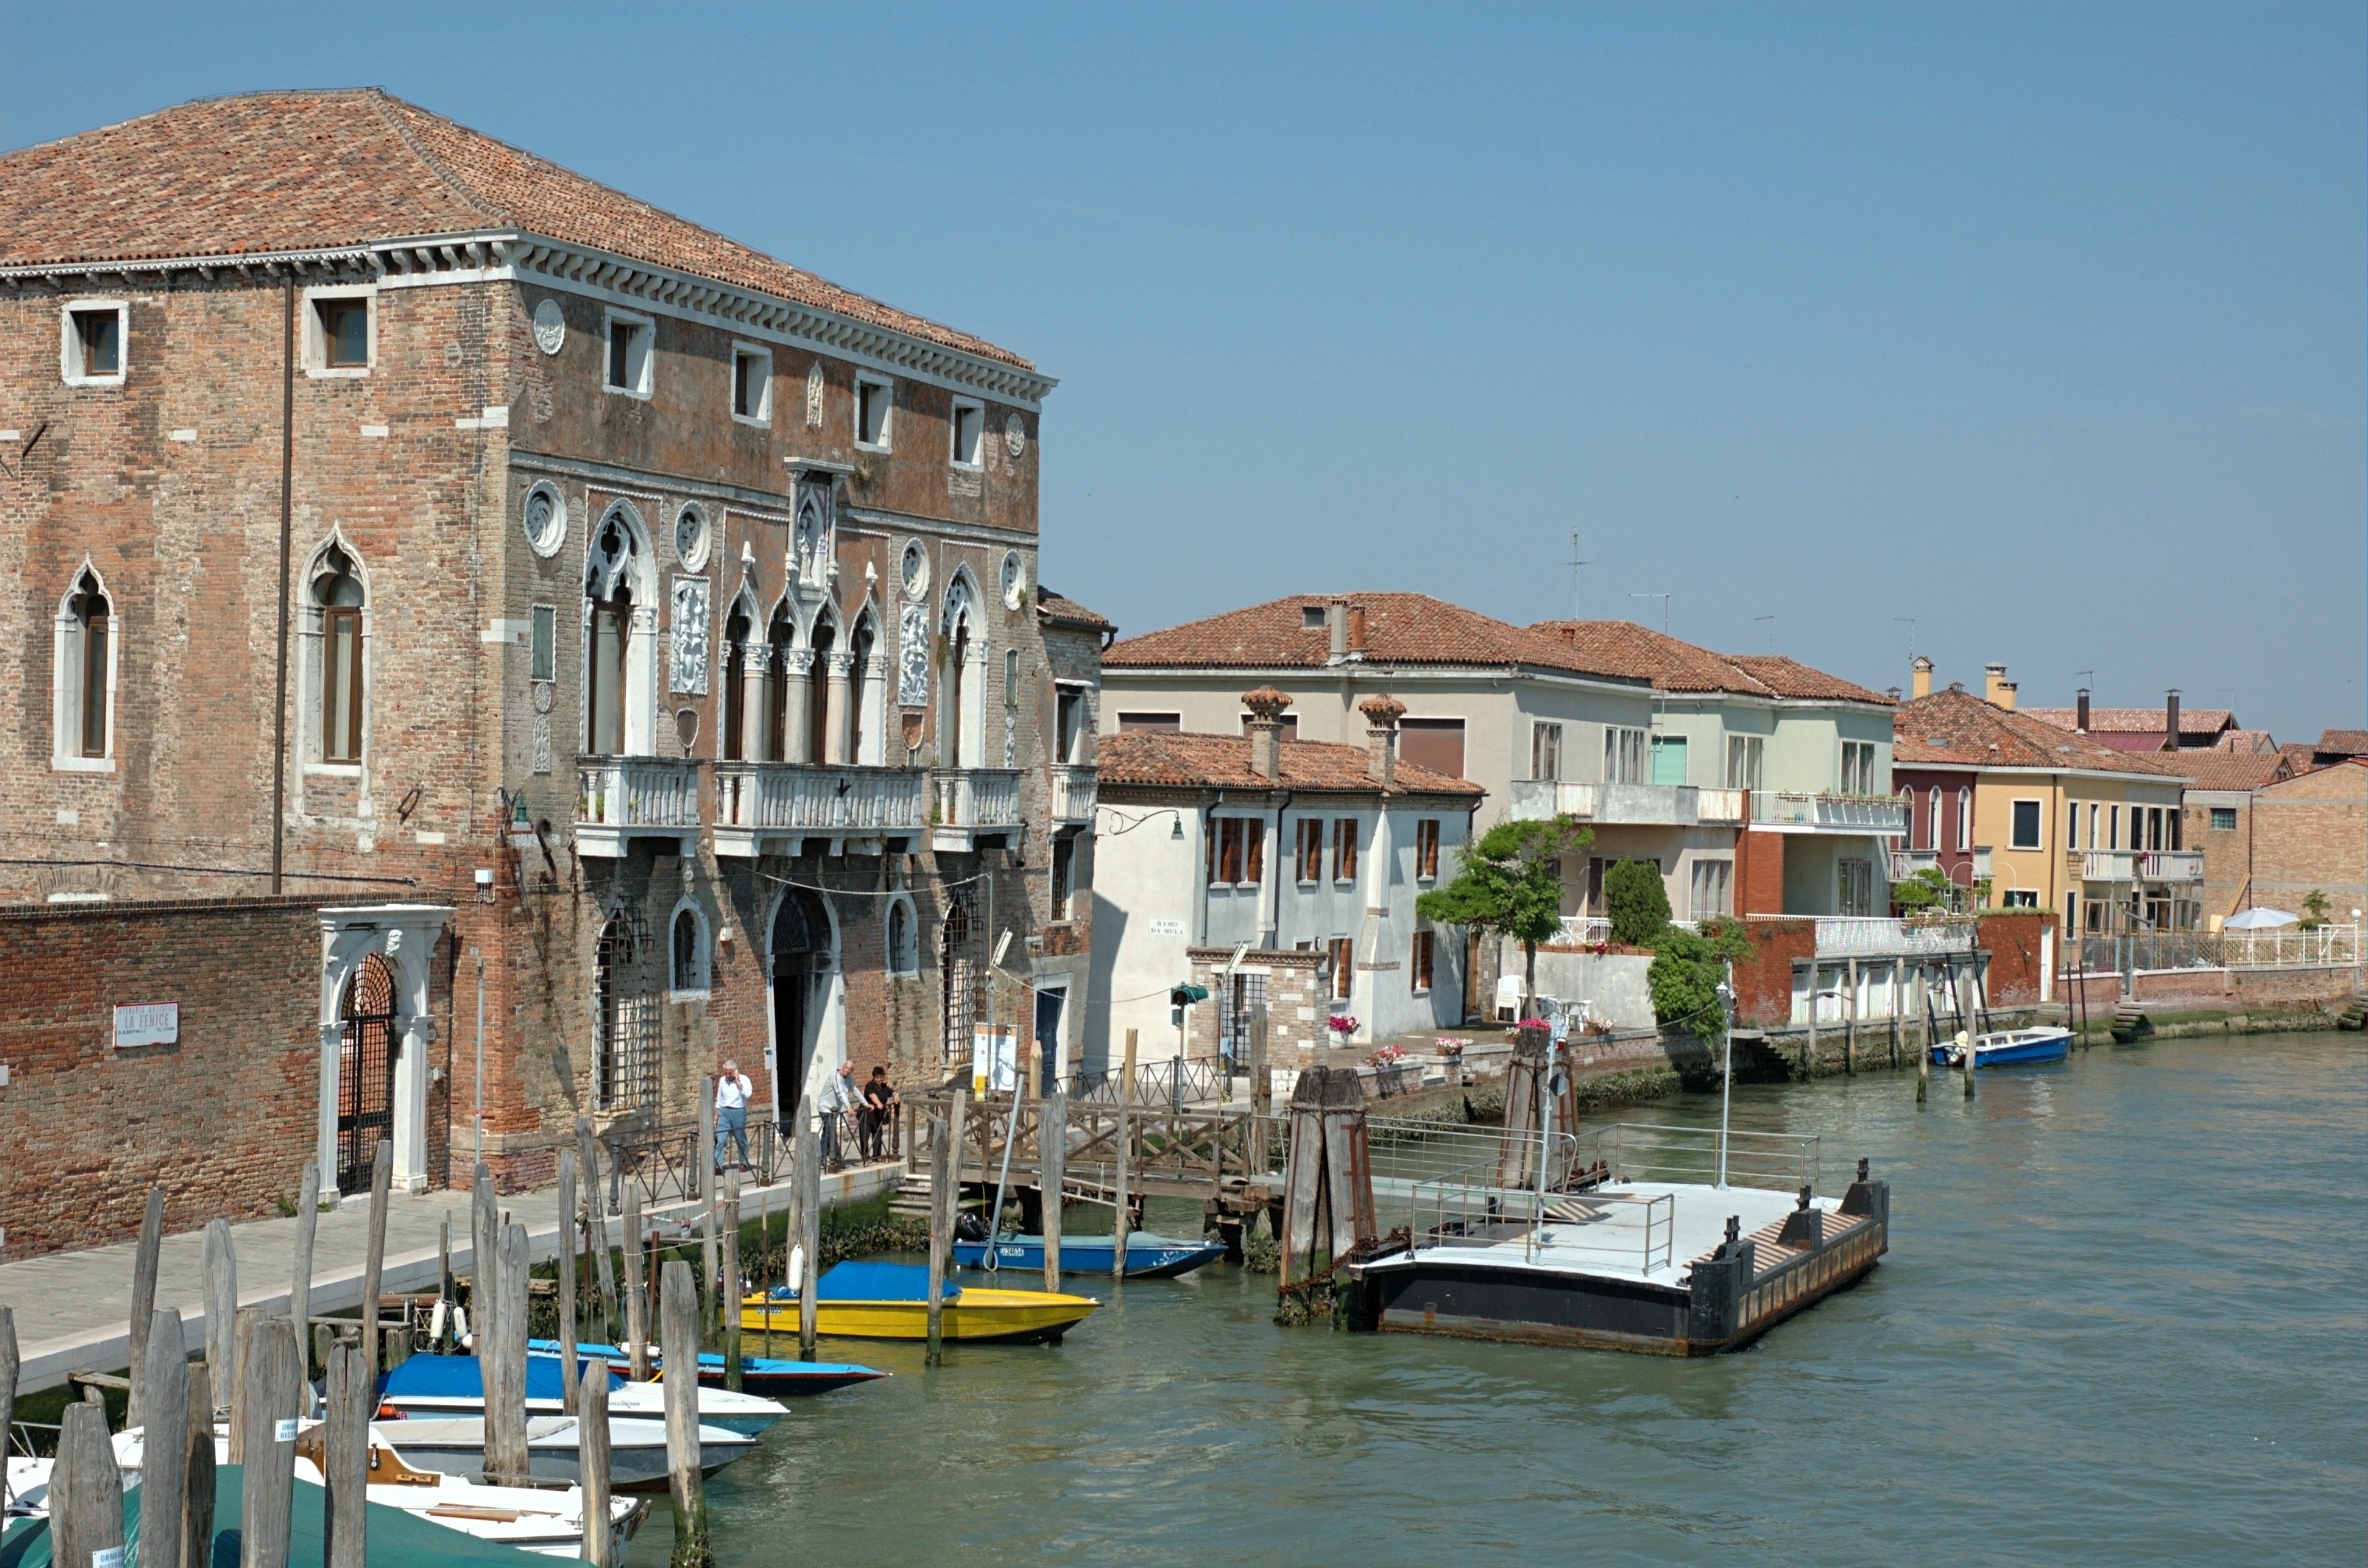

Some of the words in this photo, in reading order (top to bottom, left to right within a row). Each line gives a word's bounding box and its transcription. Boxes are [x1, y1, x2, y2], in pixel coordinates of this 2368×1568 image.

[149, 1004, 176, 1013] ARTISTICA
[125, 1015, 135, 1029] LA
[140, 1013, 169, 1028] FENICE
